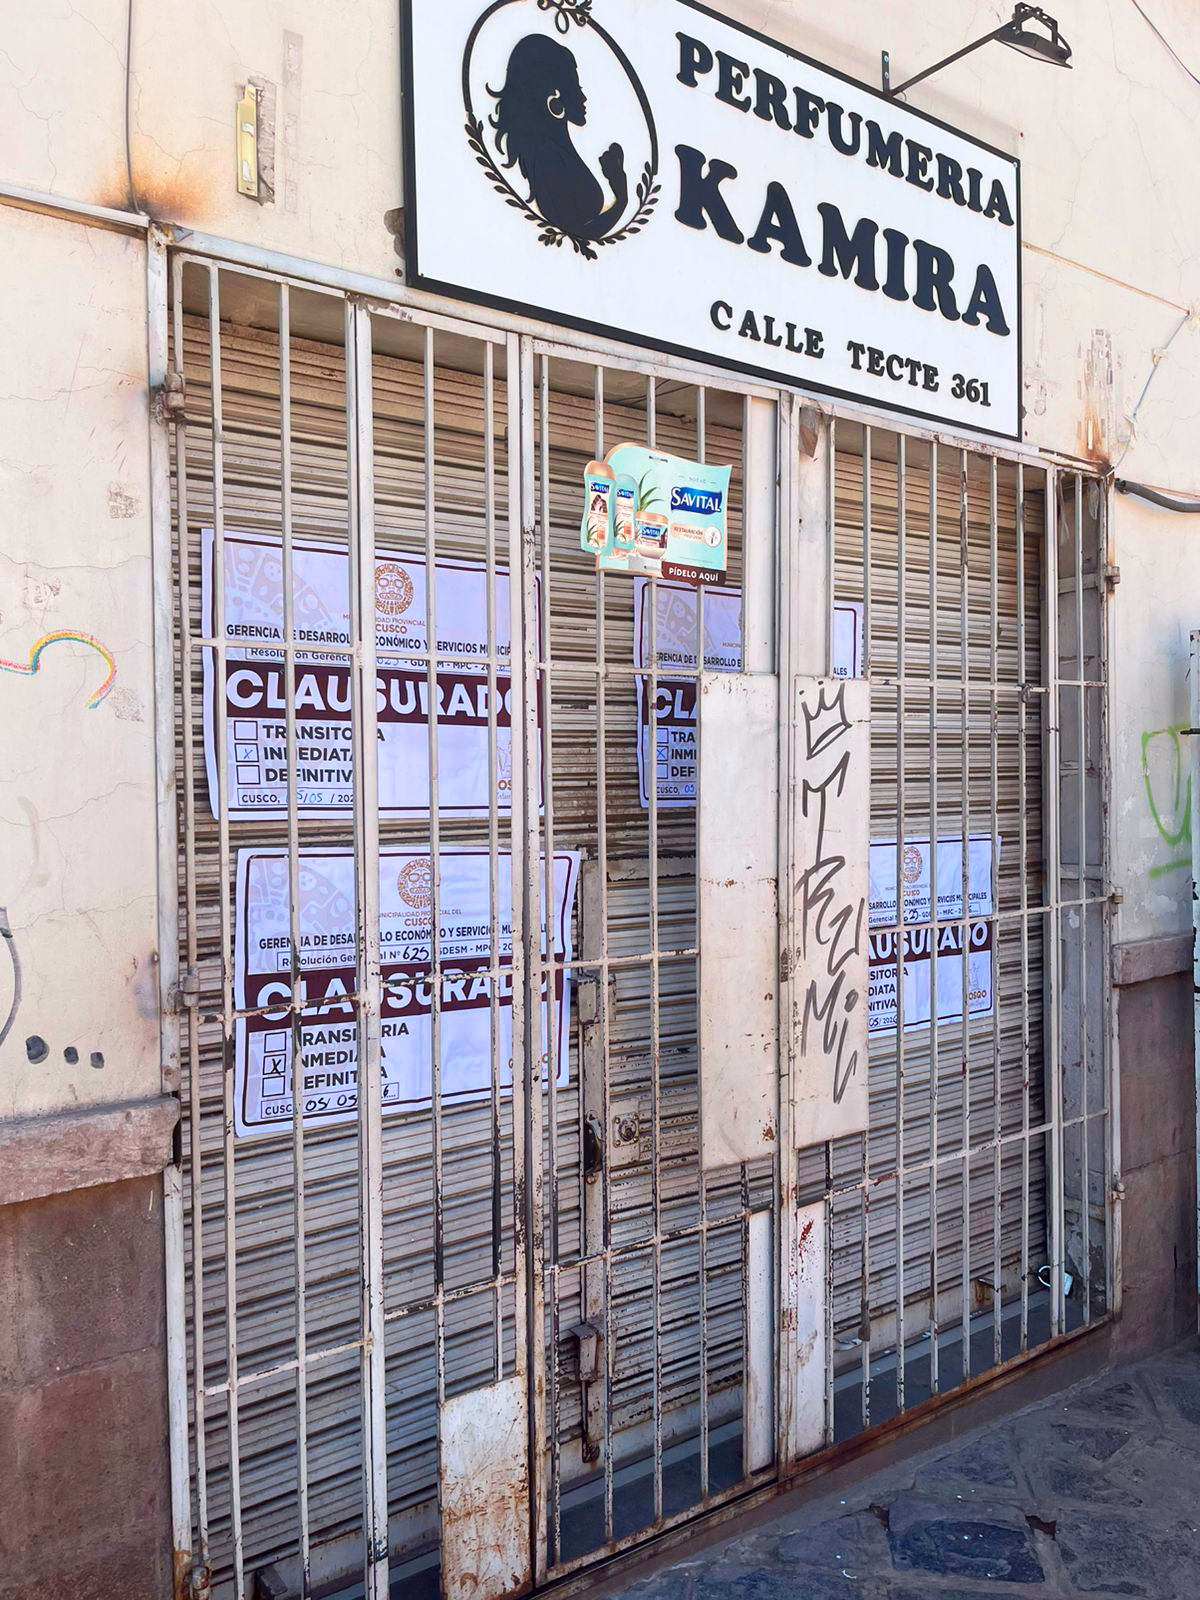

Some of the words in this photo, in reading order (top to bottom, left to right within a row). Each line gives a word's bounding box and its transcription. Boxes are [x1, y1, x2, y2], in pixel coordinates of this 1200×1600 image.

[675, 31, 1014, 226] PERFUMERIA
[674, 144, 1010, 337] KAMIRA
[710, 300, 825, 359] CALLE
[847, 341, 940, 393] TECTE
[951, 373, 992, 407] 361
[671, 487, 721, 513] SAVITAL
[669, 567, 697, 578] PÍDELO
[699, 572, 719, 582] AQUÍ
[376, 624, 408, 634] CUSCO
[226, 624, 280, 639] GERENCIA
[299, 630, 350, 644] DESARROL
[437, 641, 477, 654] ERVICIOS
[311, 654, 350, 662] Gerenci
[656, 652, 683, 662] RENCIA
[694, 656, 736, 667] SARROLLO
[262, 725, 385, 742] TRNSITOA
[263, 747, 354, 761] INEDIAT
[265, 768, 354, 783] DEINITIV
[241, 794, 281, 804] CUSCO,
[868, 900, 897, 911] SARROLLO
[937, 893, 957, 903] RVICIOS
[379, 910, 421, 918] NICIPALIDAD
[259, 934, 311, 950] GERENIA
[313, 934, 328, 946] DE
[330, 930, 393, 945] DESALO
[395, 926, 446, 942] ECONÓMO
[449, 927, 456, 938] Y
[456, 923, 491, 937] SERVICI
[868, 921, 988, 959] USUADO
[282, 954, 338, 967] Rolución
[402, 945, 430, 961] 625
[870, 966, 909, 981] SITORA
[256, 961, 547, 1022] CLASURA
[868, 983, 896, 996] DIATA
[968, 990, 987, 1000] OSQO
[868, 998, 897, 1012] NITIVA
[291, 1022, 409, 1047] RANSIRIA
[291, 1046, 387, 1069] NMEDIA
[290, 1066, 388, 1092] EFINITA
[264, 1103, 293, 1116] CUSC
